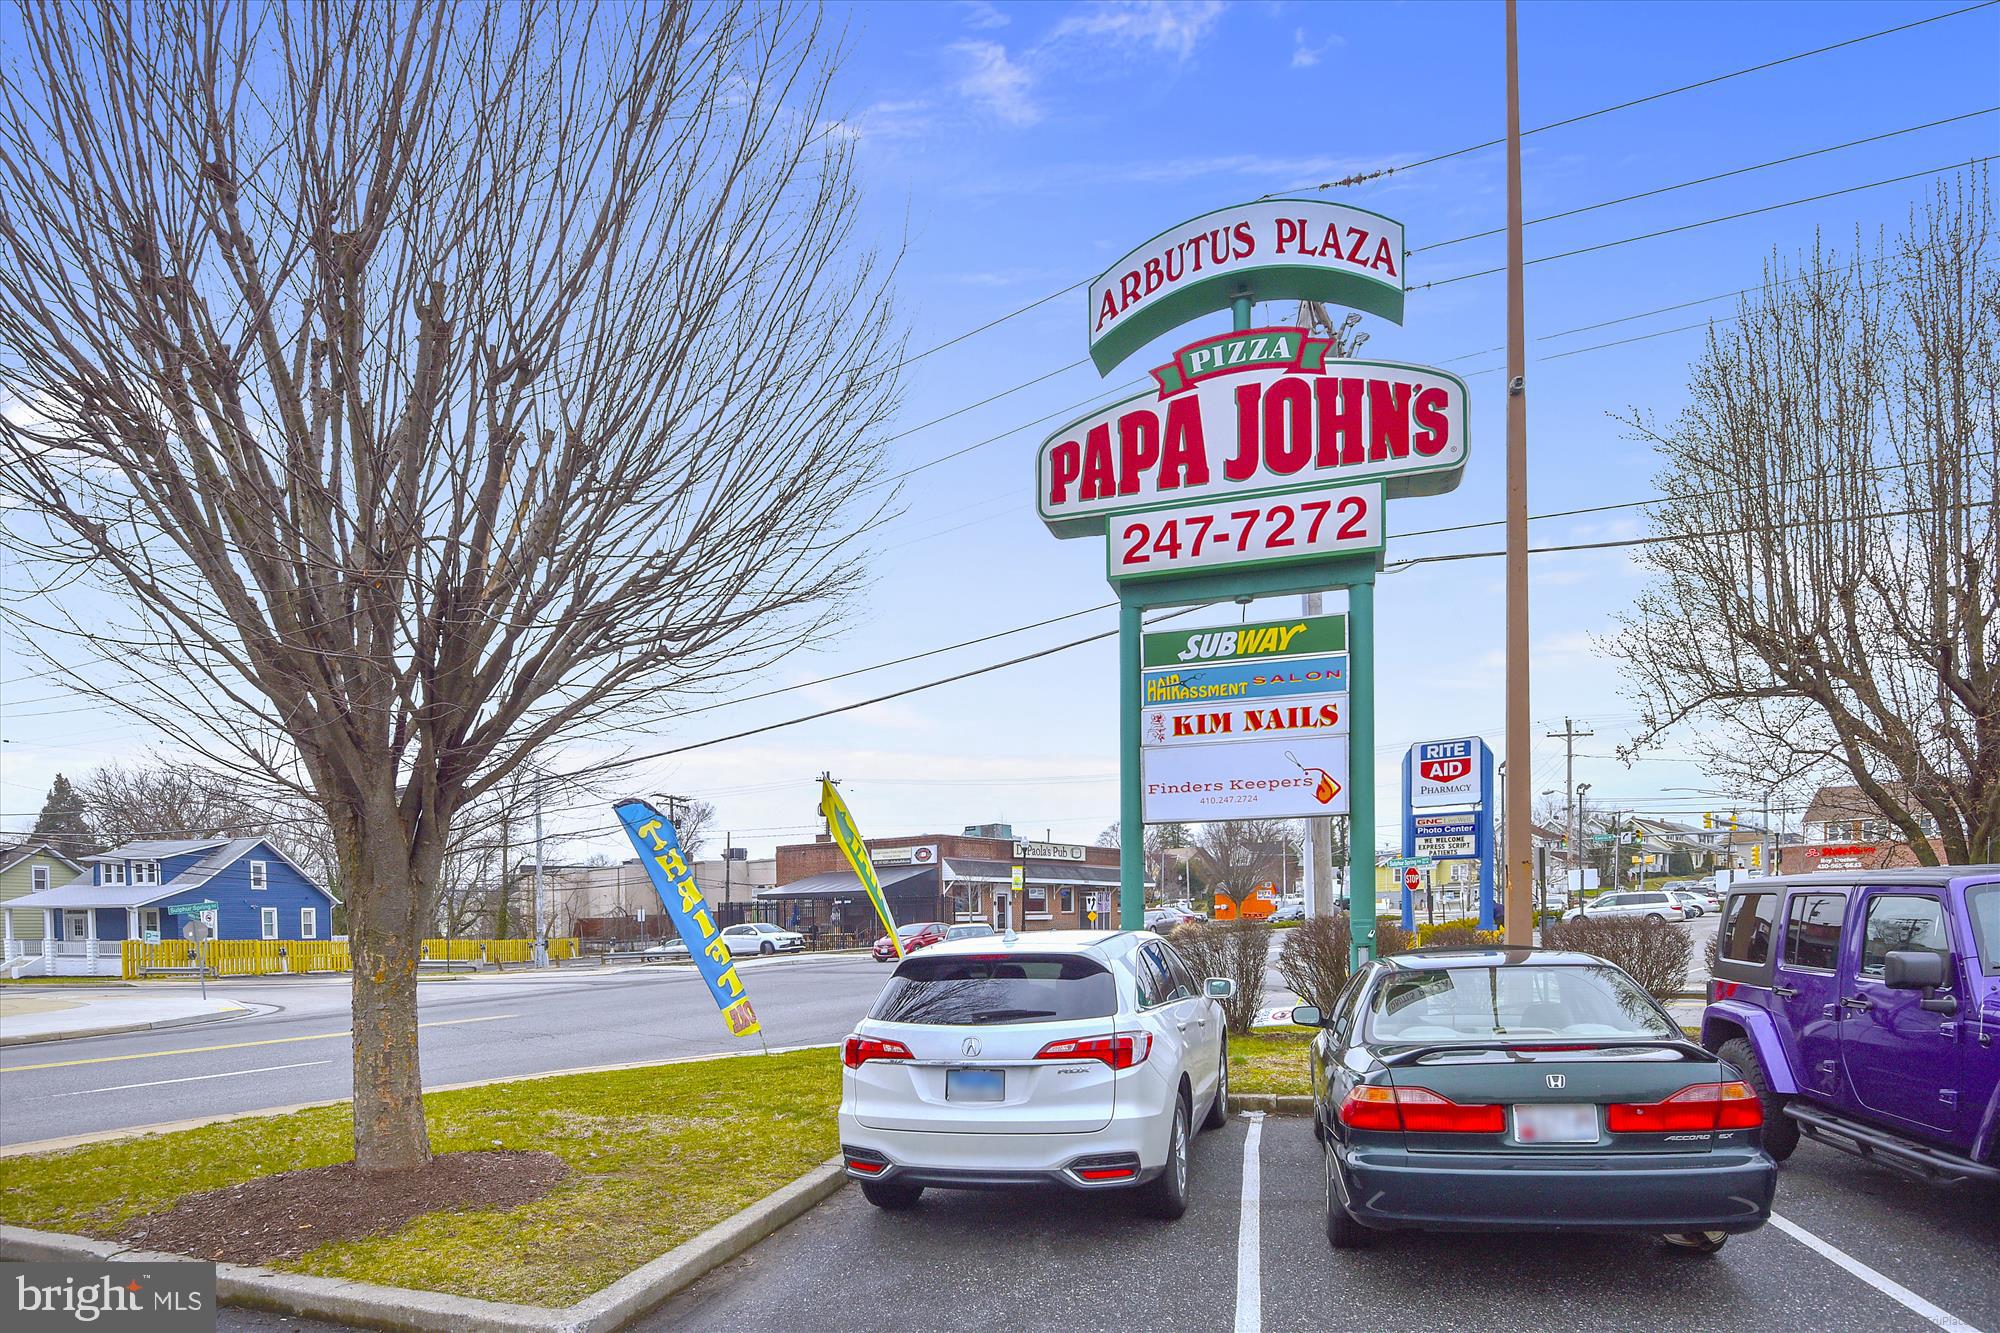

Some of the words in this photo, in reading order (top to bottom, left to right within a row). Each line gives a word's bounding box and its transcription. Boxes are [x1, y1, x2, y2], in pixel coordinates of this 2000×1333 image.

[1095, 220, 1256, 333] ARBUTUS
[1274, 217, 1397, 278] PLAZA
[1188, 331, 1292, 375] PIZZA
[1049, 393, 1210, 505] PAPA
[1222, 376, 1449, 482] JOHN'S
[1121, 495, 1369, 566] 247-7272
[1177, 622, 1308, 662] SUBWAY
[1252, 669, 1342, 685] SALON
[1172, 711, 1232, 737] KIM
[1243, 703, 1339, 732] NAILS
[1426, 742, 1466, 759] RITE
[1429, 762, 1463, 778] AID
[1148, 780, 1223, 795] Finders
[1229, 775, 1313, 793] Keepers
[1199, 794, 1259, 805] 410.247.2724
[1417, 826, 1443, 834] Photo
[1444, 824, 1474, 833] Center
[1016, 843, 1052, 857] DPaola's
[1053, 846, 1068, 858] Pub
[1405, 874, 1420, 884] STOP
[1057, 1066, 1091, 1075] RDX
[1663, 1133, 1711, 1141] ACCORD
